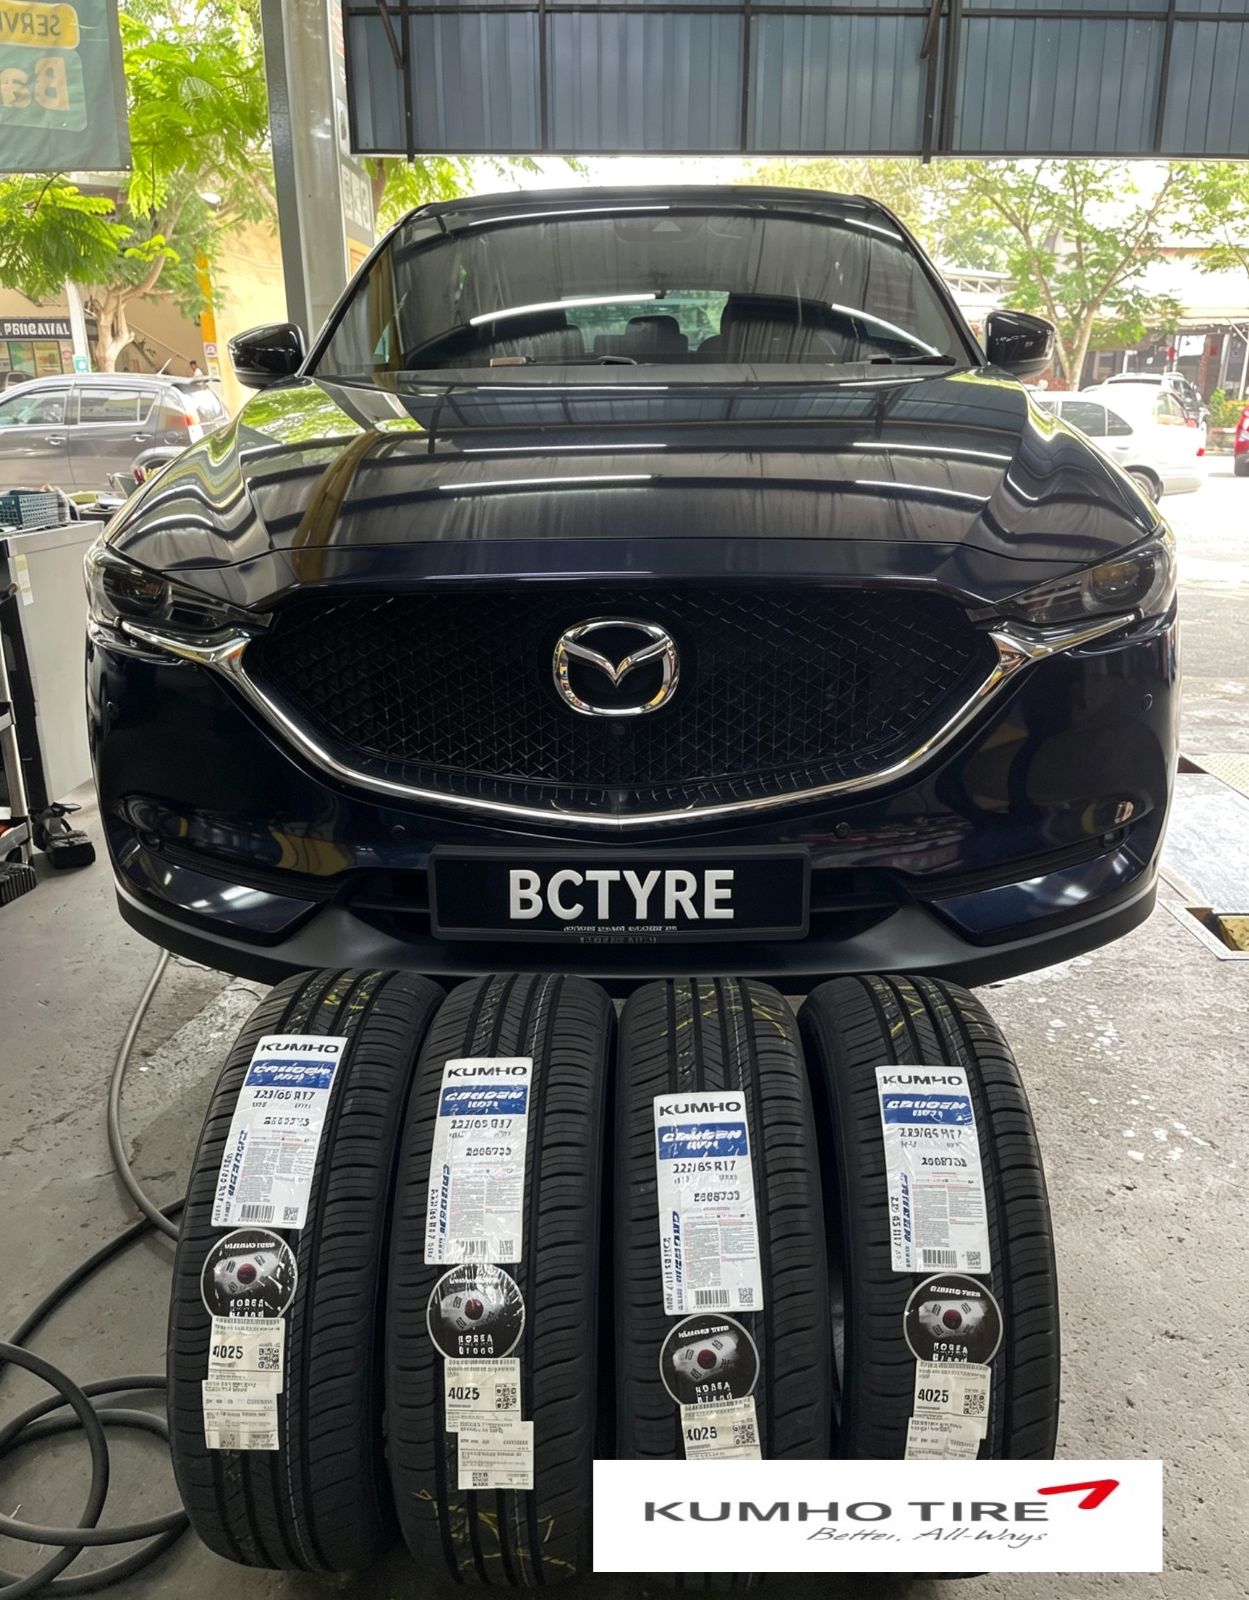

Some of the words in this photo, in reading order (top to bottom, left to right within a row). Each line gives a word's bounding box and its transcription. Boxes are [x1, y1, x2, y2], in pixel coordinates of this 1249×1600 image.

[509, 869, 735, 920] BCTYRE
[261, 1043, 339, 1054] KUMHO
[447, 1066, 528, 1078] KUMHO
[882, 1075, 963, 1086] KUMHO
[659, 1101, 742, 1117] KUMHO
[447, 1386, 480, 1401] 4025
[917, 1388, 949, 1403] 4025
